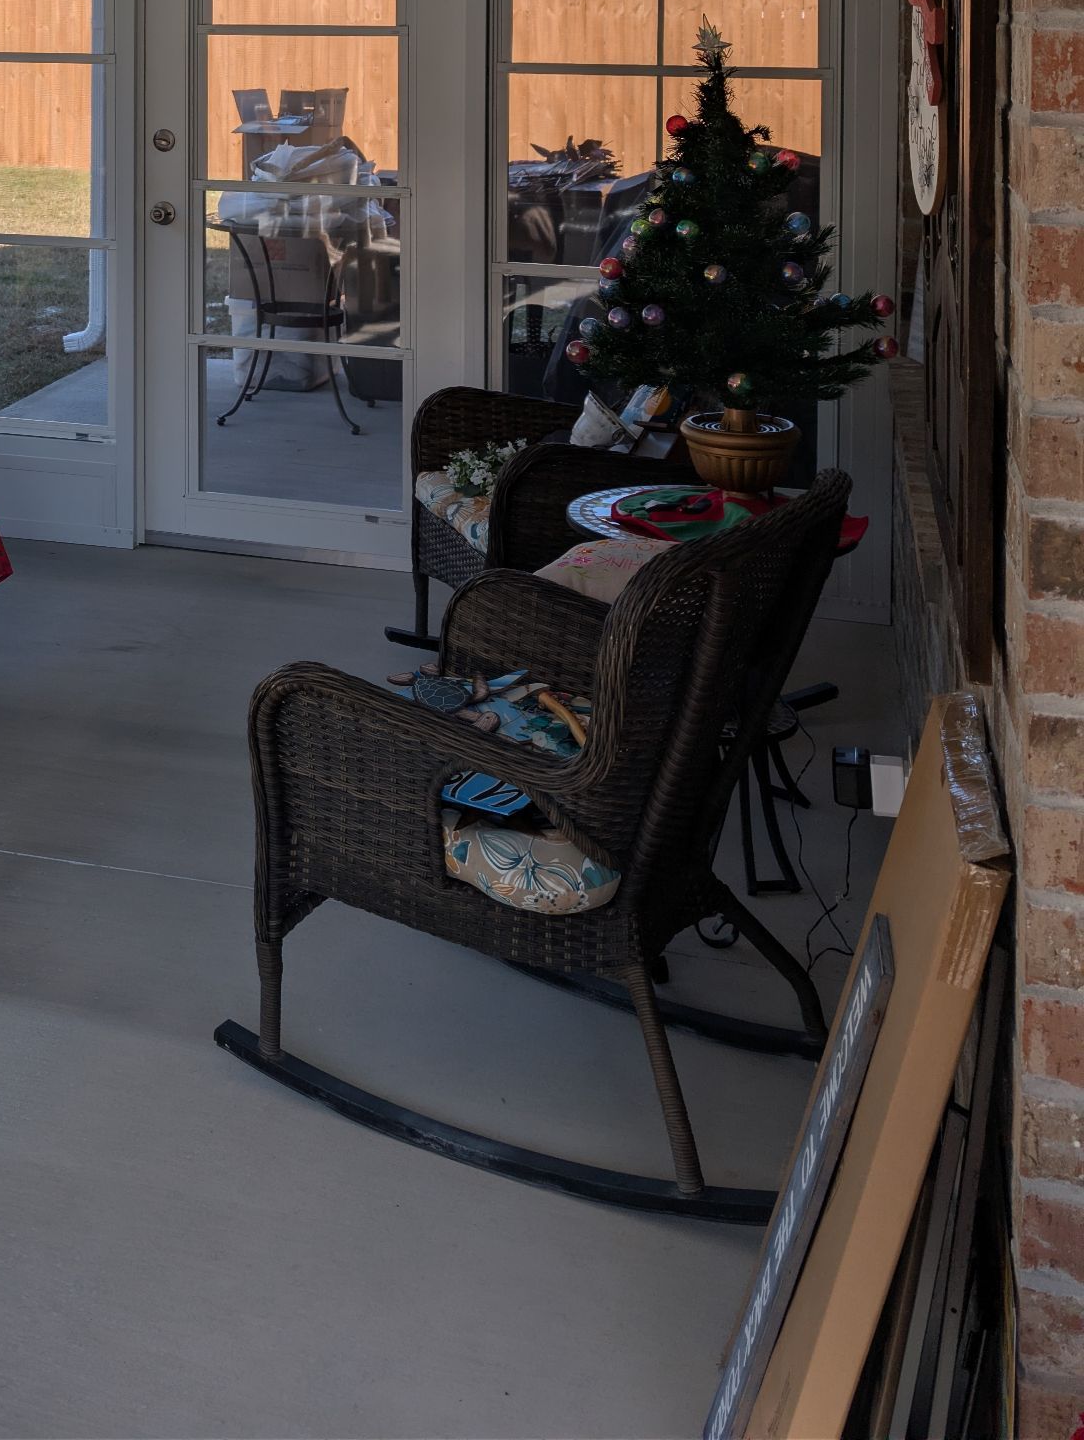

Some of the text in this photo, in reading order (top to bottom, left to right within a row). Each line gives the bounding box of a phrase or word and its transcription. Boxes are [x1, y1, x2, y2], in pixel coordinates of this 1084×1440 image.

[596, 554, 644, 570] HINK
[819, 964, 872, 1140] WELCOME
[801, 1133, 818, 1190] TO
[773, 1189, 796, 1274] THE
[742, 1257, 771, 1368] BACK
